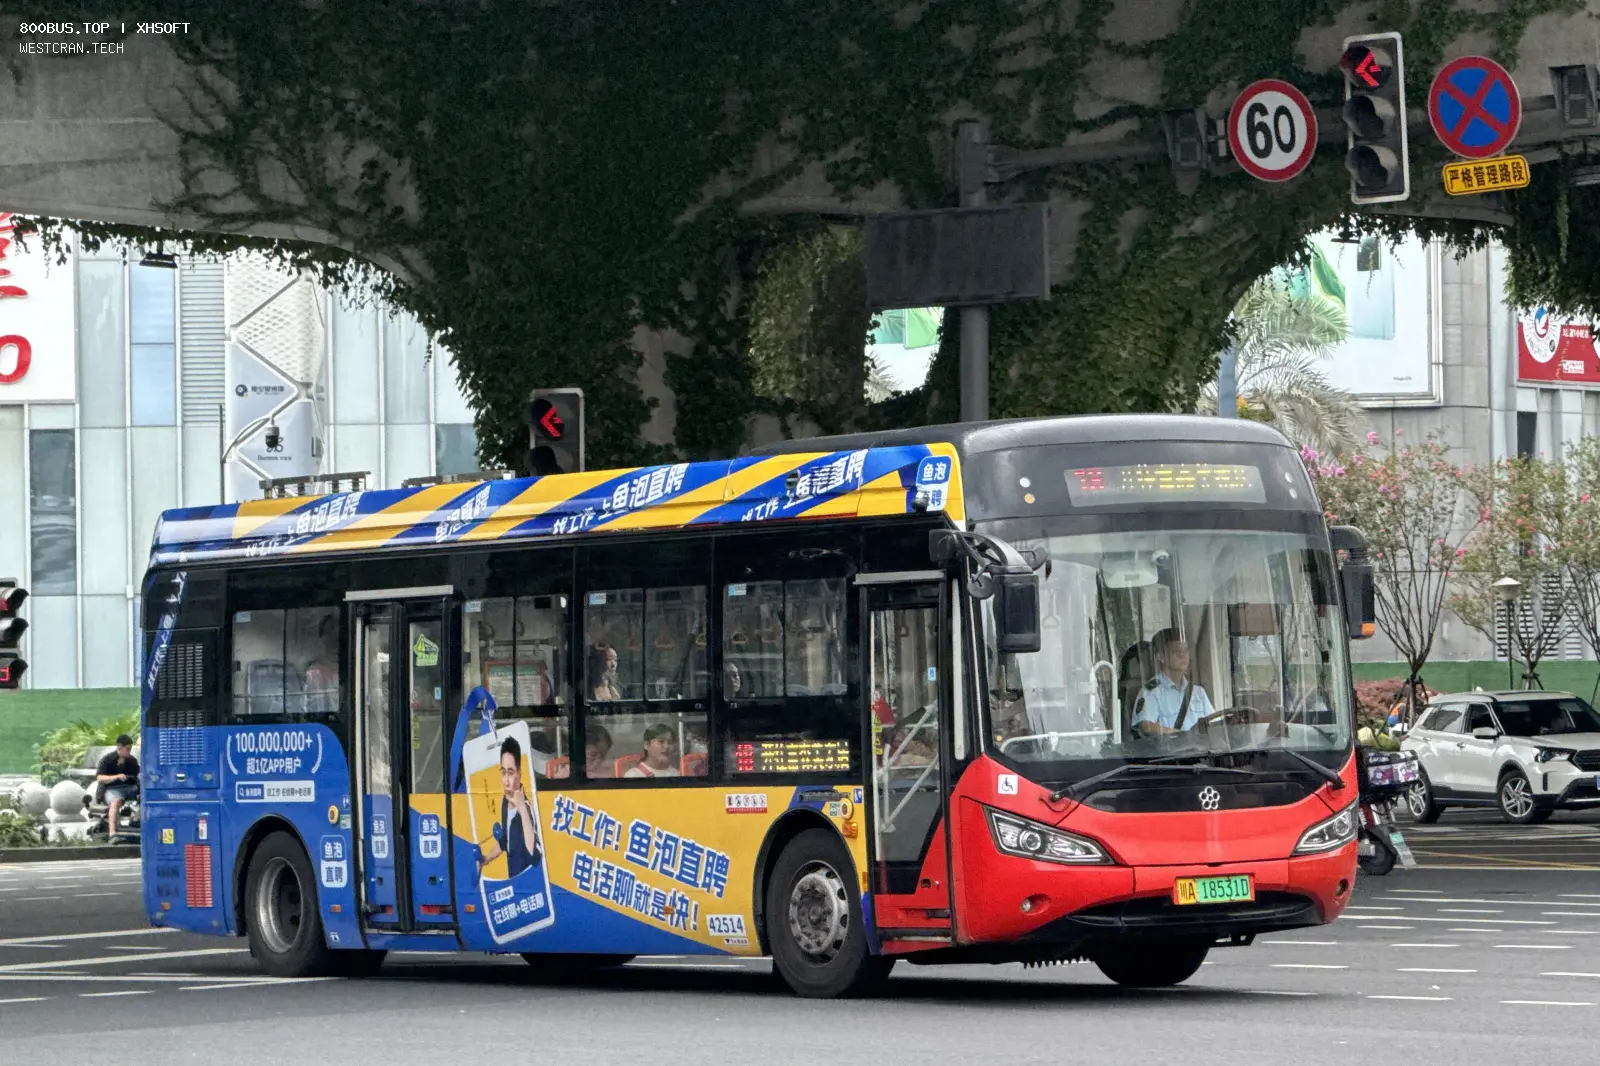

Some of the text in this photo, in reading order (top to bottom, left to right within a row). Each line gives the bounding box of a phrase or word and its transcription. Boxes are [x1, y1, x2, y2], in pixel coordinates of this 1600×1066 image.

[1246, 102, 1296, 159] 60
[1447, 160, 1525, 191] 严格管理路段
[922, 462, 947, 482] 鱼泡
[235, 731, 313, 755] 100,000,000+
[246, 757, 302, 775] 超1亿APP用户
[422, 818, 438, 833] 鱼泡
[324, 841, 343, 858] 鱼泡
[423, 839, 438, 854] 直聘
[623, 819, 731, 899] 鱼泡直聘
[325, 866, 344, 883] 直聘
[1202, 878, 1249, 899] 18531D
[709, 916, 744, 934] 42514
